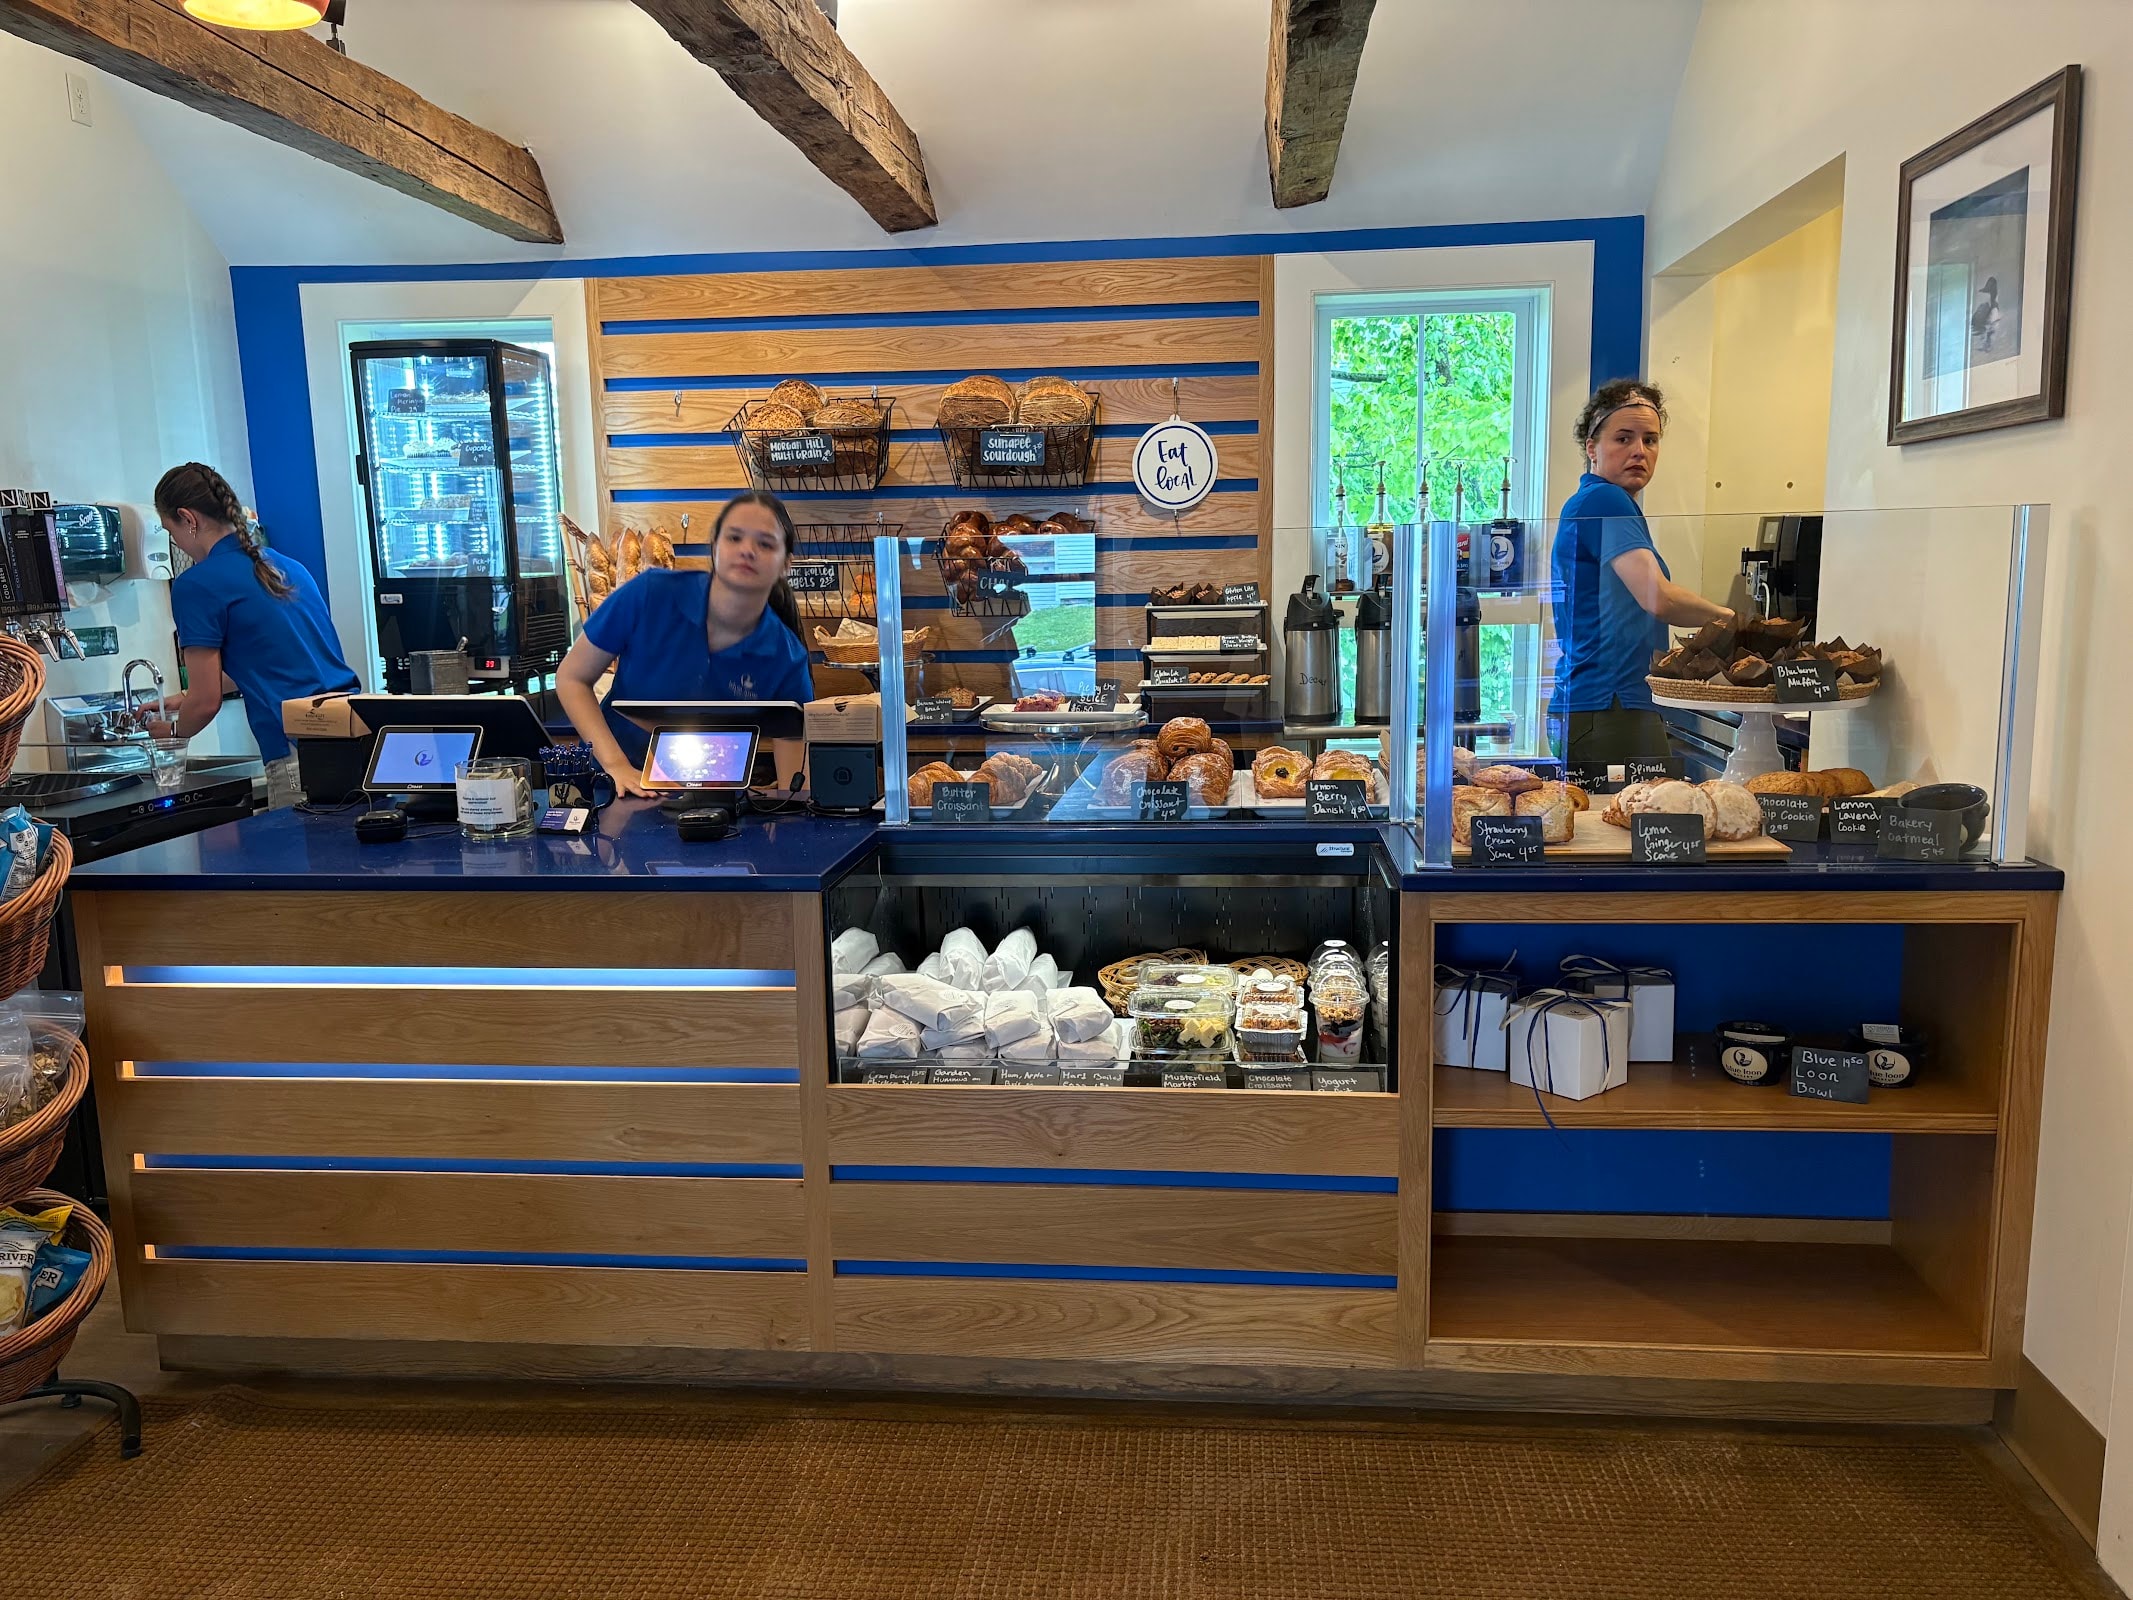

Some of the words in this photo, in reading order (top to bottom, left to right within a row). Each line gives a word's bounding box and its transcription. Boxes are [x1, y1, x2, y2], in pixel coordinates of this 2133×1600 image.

[1157, 440, 1188, 467] Eat
[787, 577, 816, 590] agels
[941, 786, 977, 799] Butter
[1309, 781, 1339, 791] Lemon
[1316, 791, 1348, 805] Berry
[1756, 797, 1809, 809] Chocolate
[937, 799, 984, 812] Croissant
[1312, 803, 1345, 815] Danish
[1833, 800, 1875, 810] Lemon
[1780, 810, 1816, 821] Cookie
[1838, 810, 1882, 821] Lavend
[1476, 819, 1528, 839] Strawberry
[1638, 818, 1673, 838] Lemon
[1837, 821, 1867, 832] Cookie
[1889, 814, 1933, 832] Bakery
[1484, 834, 1516, 847] Cream
[1644, 835, 1682, 853] Ginger
[1488, 845, 1516, 861] Scone
[1644, 849, 1679, 862] Scone
[1802, 1050, 1838, 1067] Blue
[934, 1068, 972, 1077] Garden
[1164, 1073, 1222, 1083] Musterfield
[1248, 1074, 1293, 1083] Chocolate
[1743, 1068, 1763, 1077] loon
[1795, 1064, 1840, 1083] Loon
[1869, 1069, 1885, 1079] lue
[1885, 1071, 1905, 1080] loon
[1317, 1076, 1358, 1089] Yogurt
[1796, 1080, 1834, 1099] Bowl
